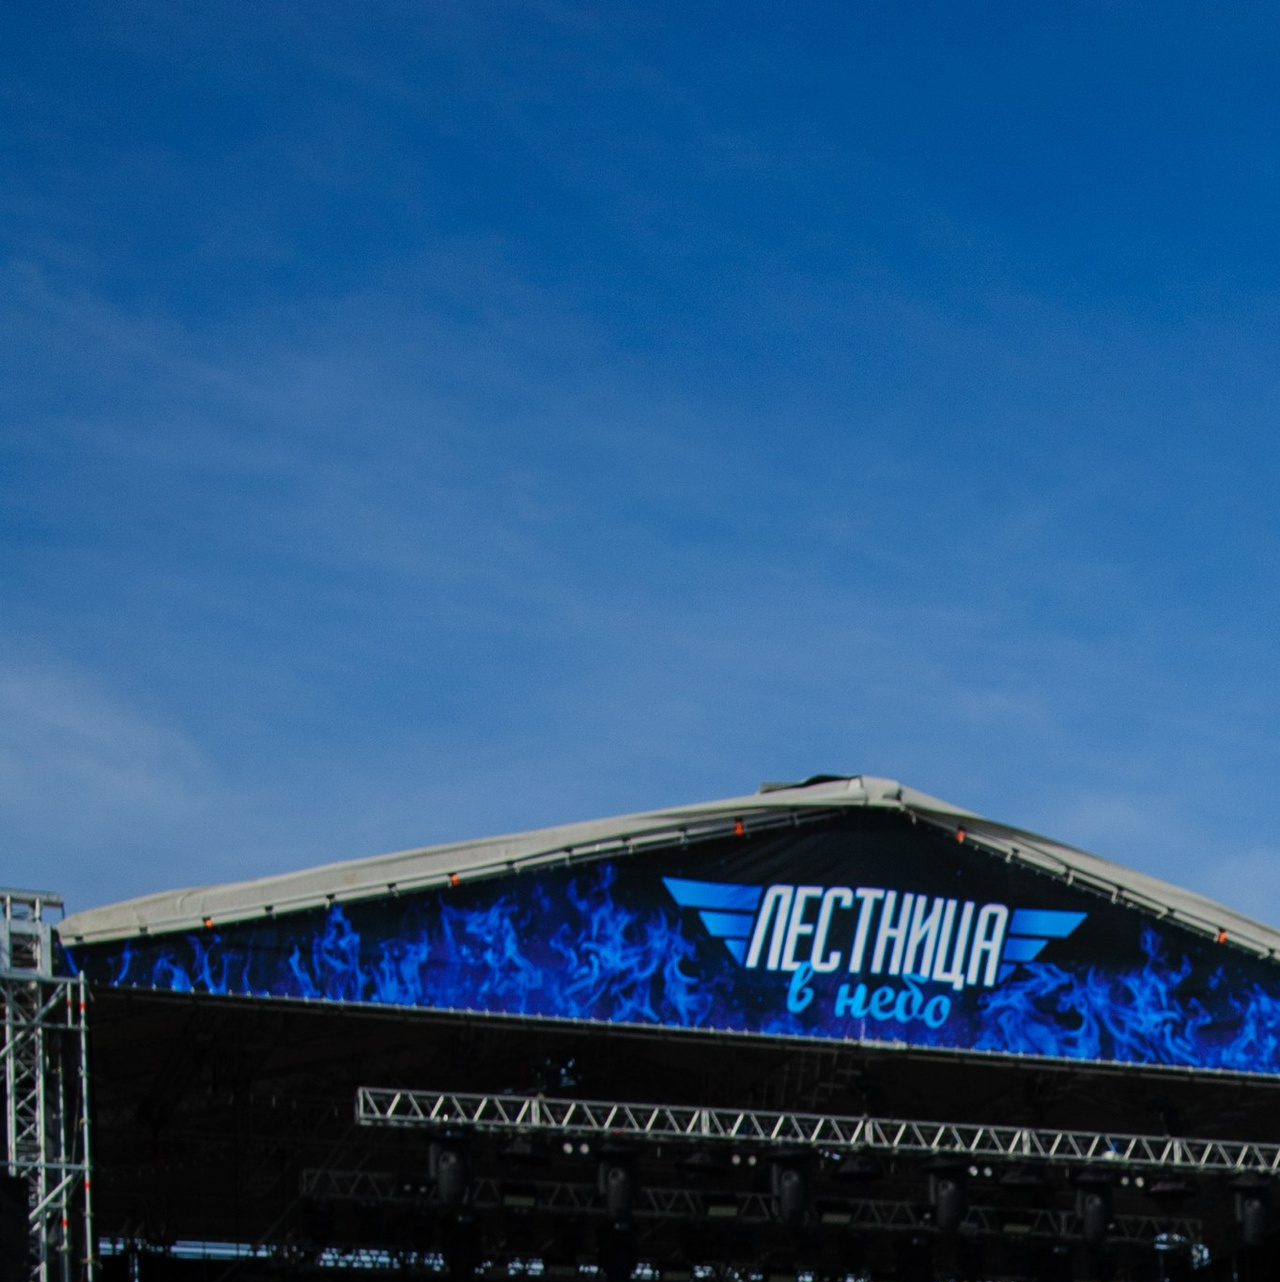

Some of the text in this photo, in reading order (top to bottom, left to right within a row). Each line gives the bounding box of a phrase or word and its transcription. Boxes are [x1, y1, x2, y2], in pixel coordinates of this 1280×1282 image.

[745, 884, 1010, 990] ЛЕСТНИЦА
[786, 960, 952, 1028] в небо
